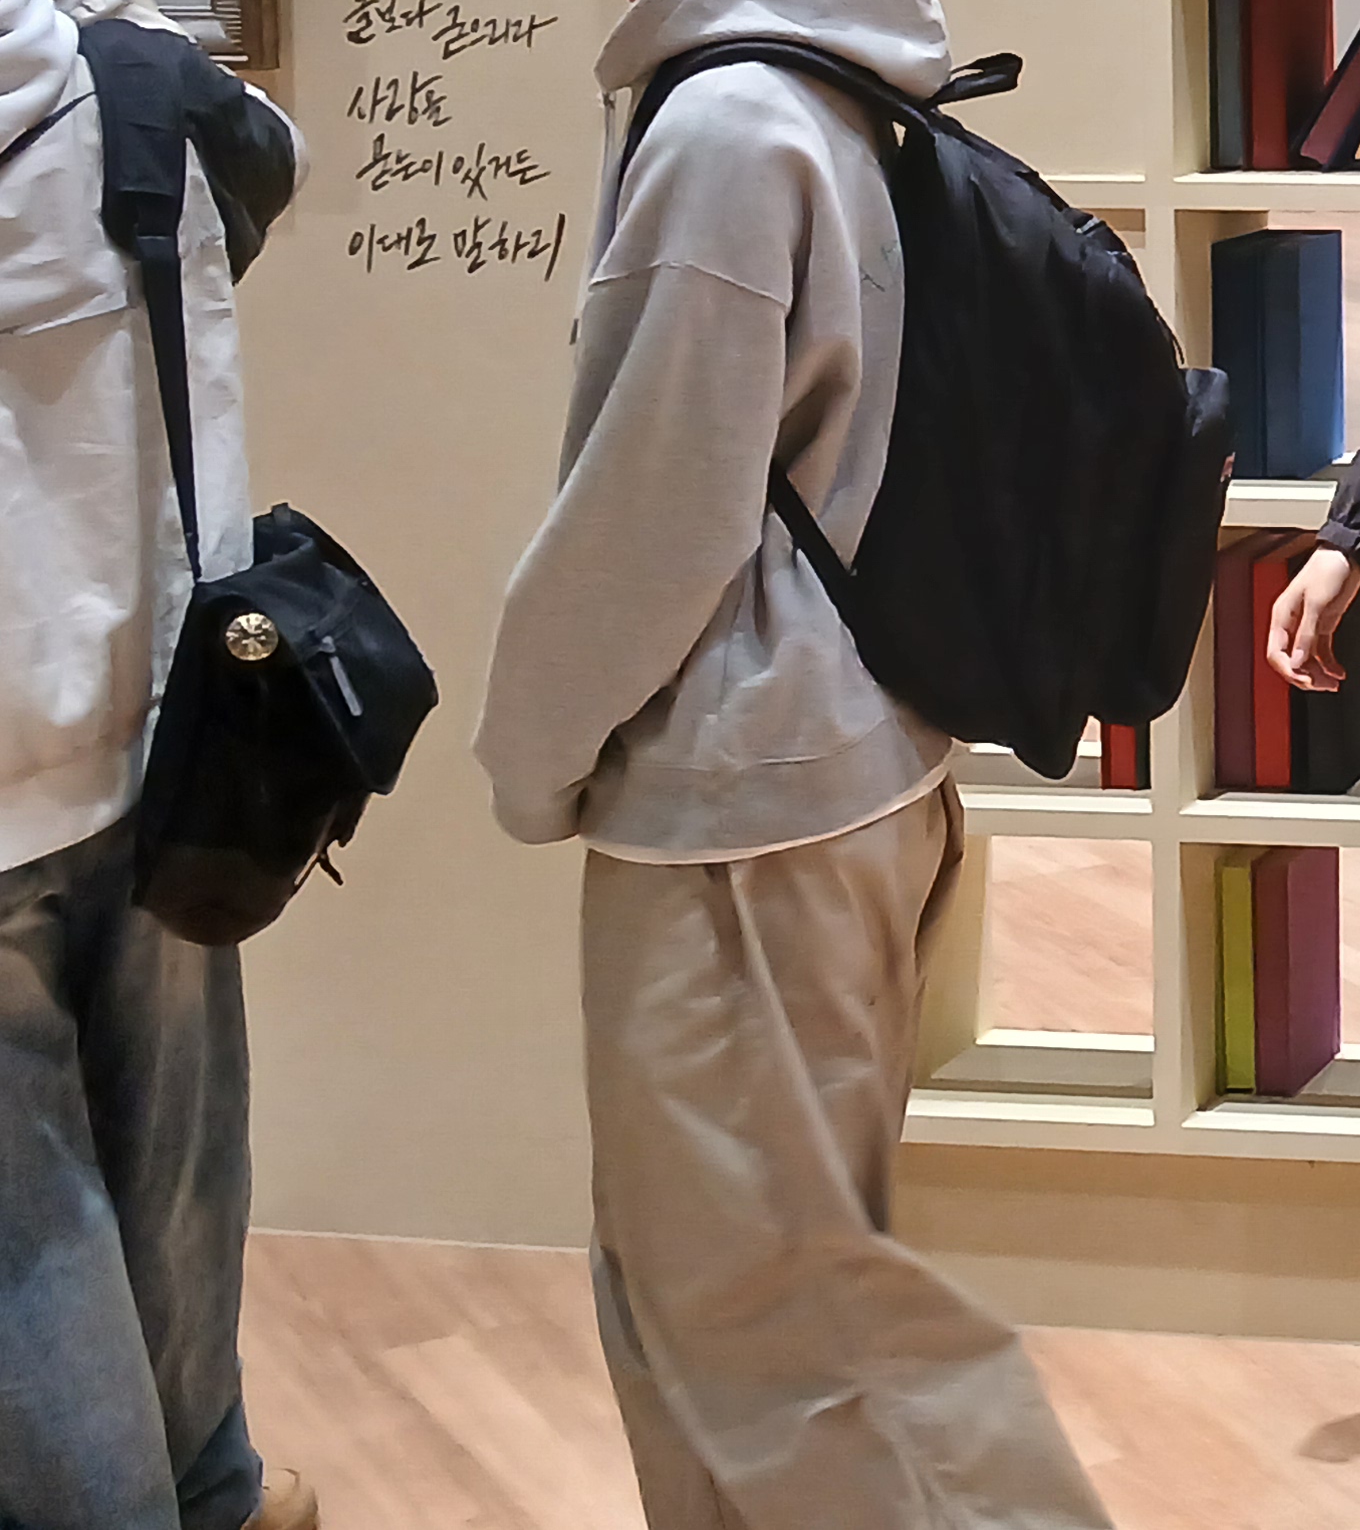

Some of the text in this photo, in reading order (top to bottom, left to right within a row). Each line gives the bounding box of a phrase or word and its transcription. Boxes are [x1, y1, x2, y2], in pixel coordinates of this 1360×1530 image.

[347, 71, 452, 127] 사랑을
[451, 142, 551, 200] 있거든
[349, 213, 565, 282] 이대로 말하리
